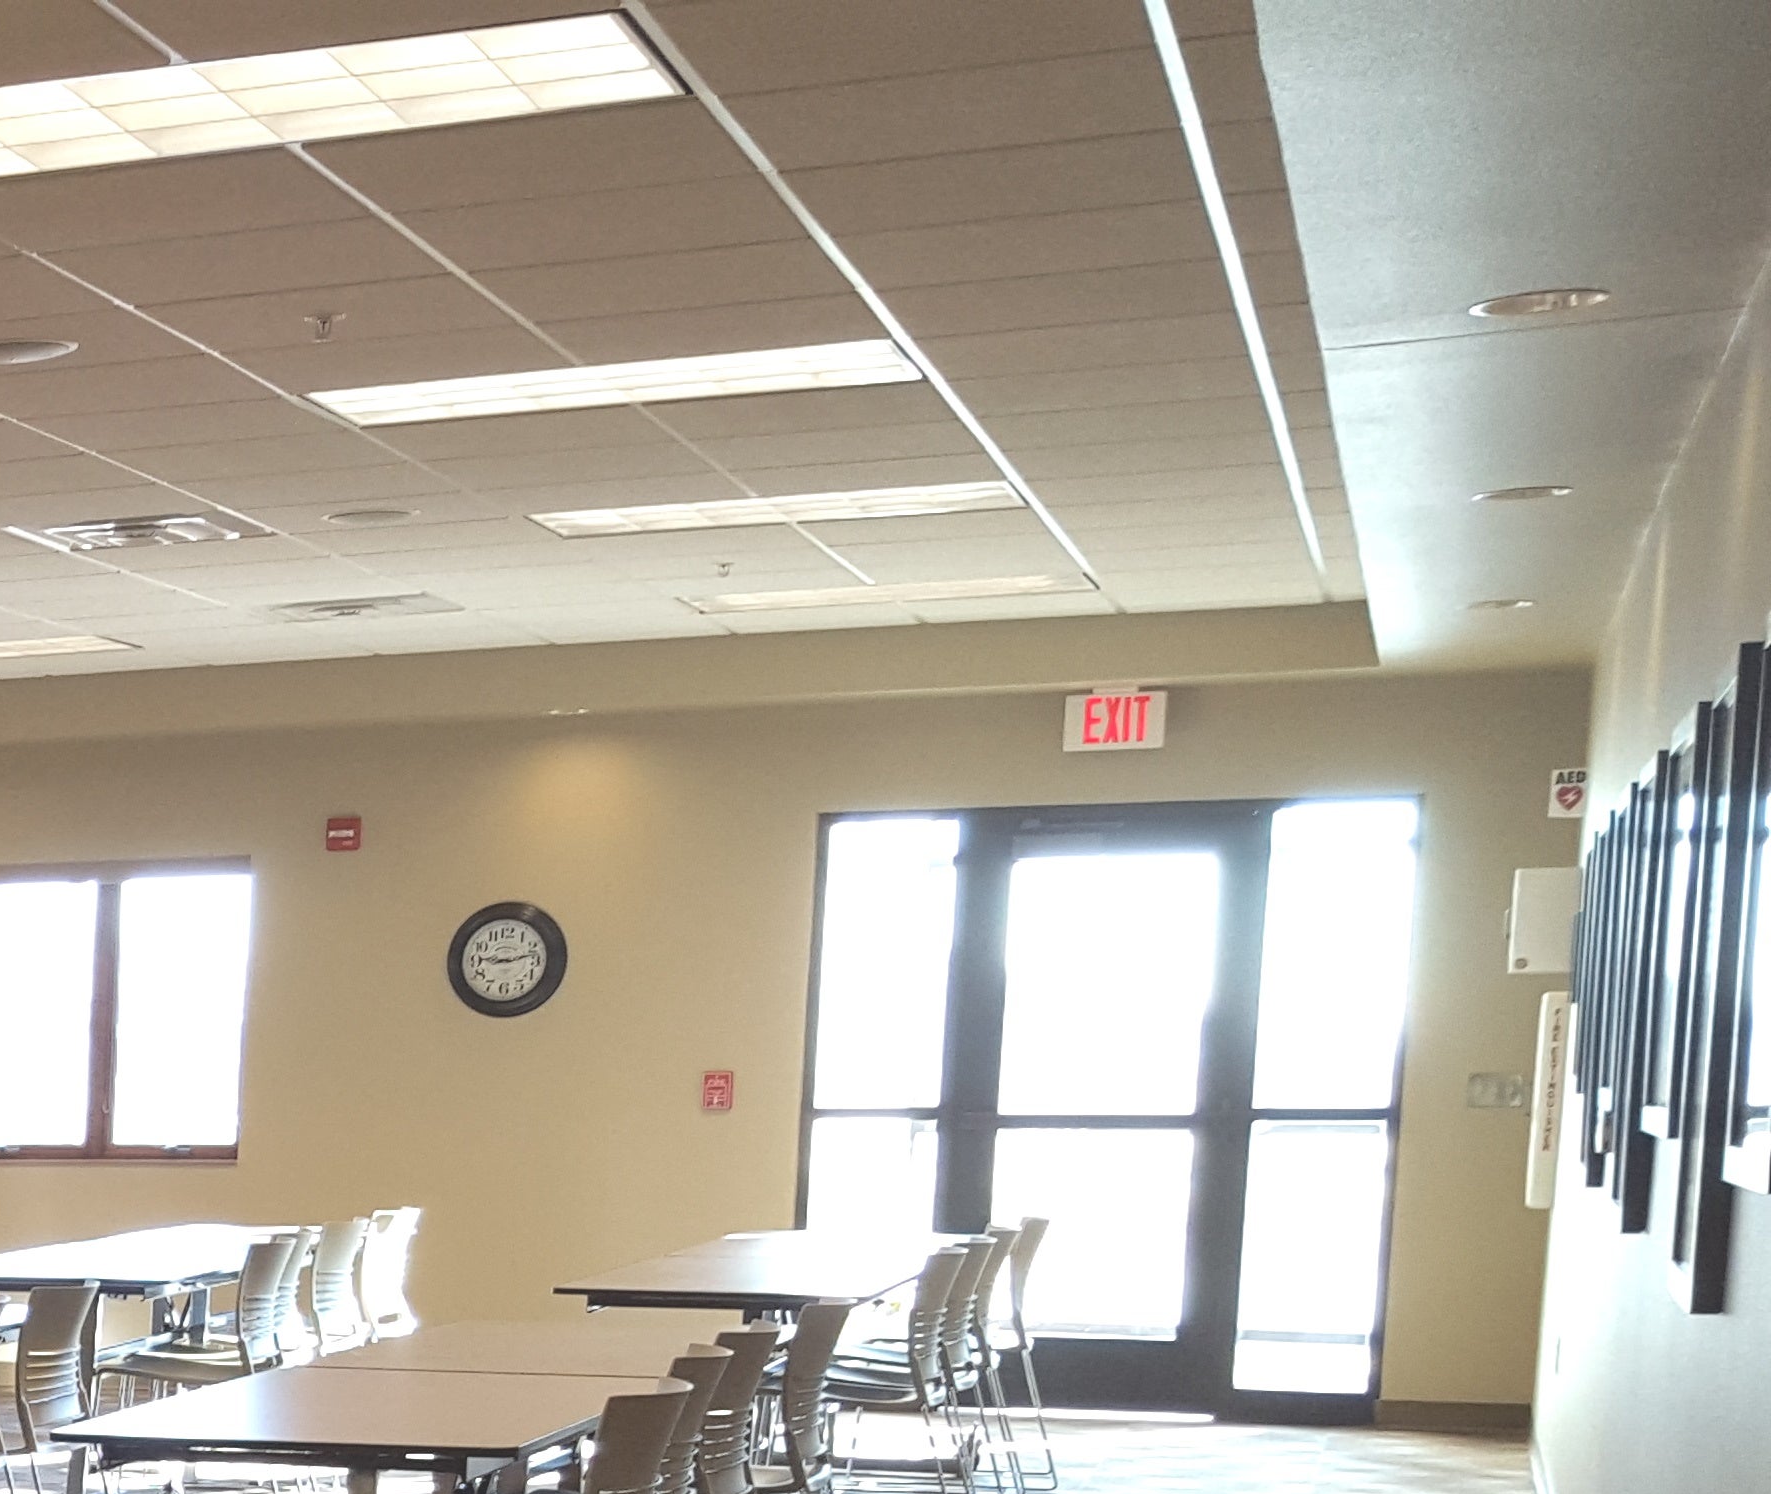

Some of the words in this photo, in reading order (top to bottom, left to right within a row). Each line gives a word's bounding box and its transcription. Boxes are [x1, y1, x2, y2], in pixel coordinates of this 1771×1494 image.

[1083, 695, 1151, 744] EXIT
[1555, 770, 1586, 785] AED
[488, 930, 498, 941] 11
[500, 927, 515, 939] 12
[520, 931, 525, 942] 1
[476, 940, 488, 952] 10
[528, 941, 538, 953] 2
[470, 954, 482, 968] 9
[530, 954, 541, 967] 3
[474, 968, 485, 981] 8
[485, 980, 495, 992] 7
[498, 982, 510, 995] 6
[513, 979, 524, 991] 5
